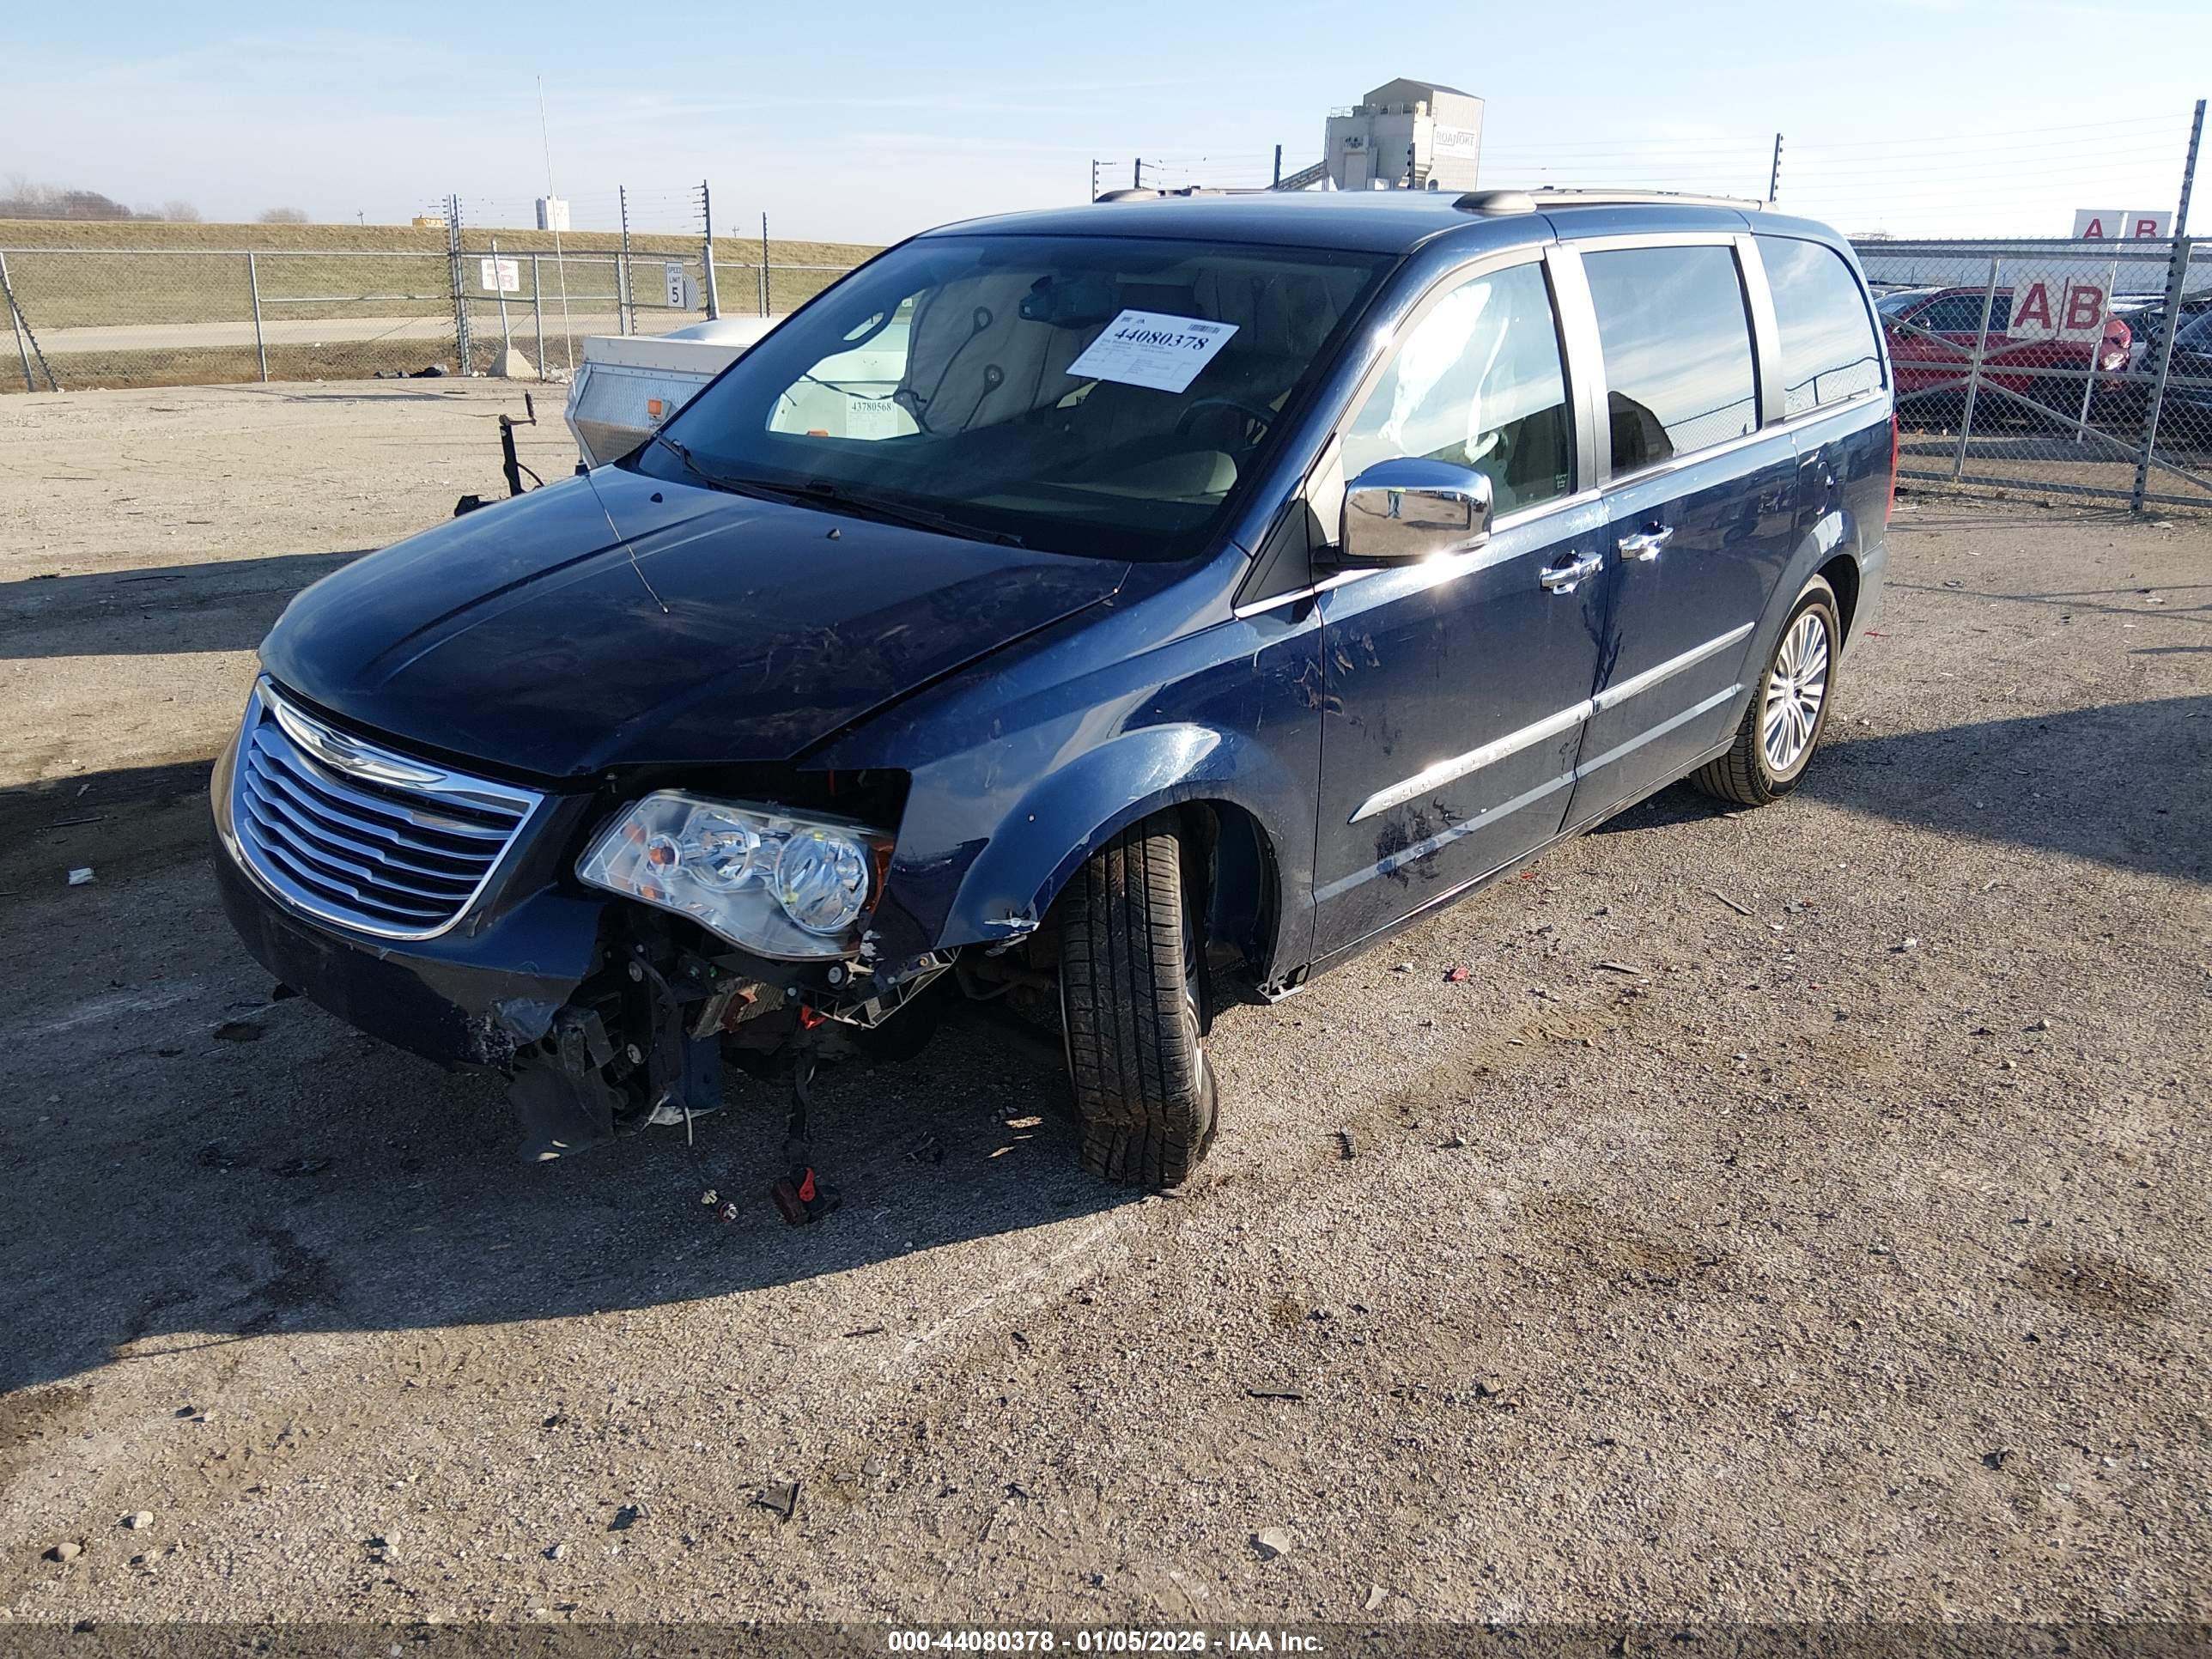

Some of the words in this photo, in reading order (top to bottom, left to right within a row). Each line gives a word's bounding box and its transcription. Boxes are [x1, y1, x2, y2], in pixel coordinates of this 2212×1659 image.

[2083, 218, 2103, 239] A
[672, 287, 679, 303] 5
[2013, 283, 2052, 330] A
[2065, 285, 2103, 330] B
[1115, 327, 1209, 351] 44080378
[851, 401, 892, 412] 43780568
[1382, 743, 1513, 807] CHRSLER
